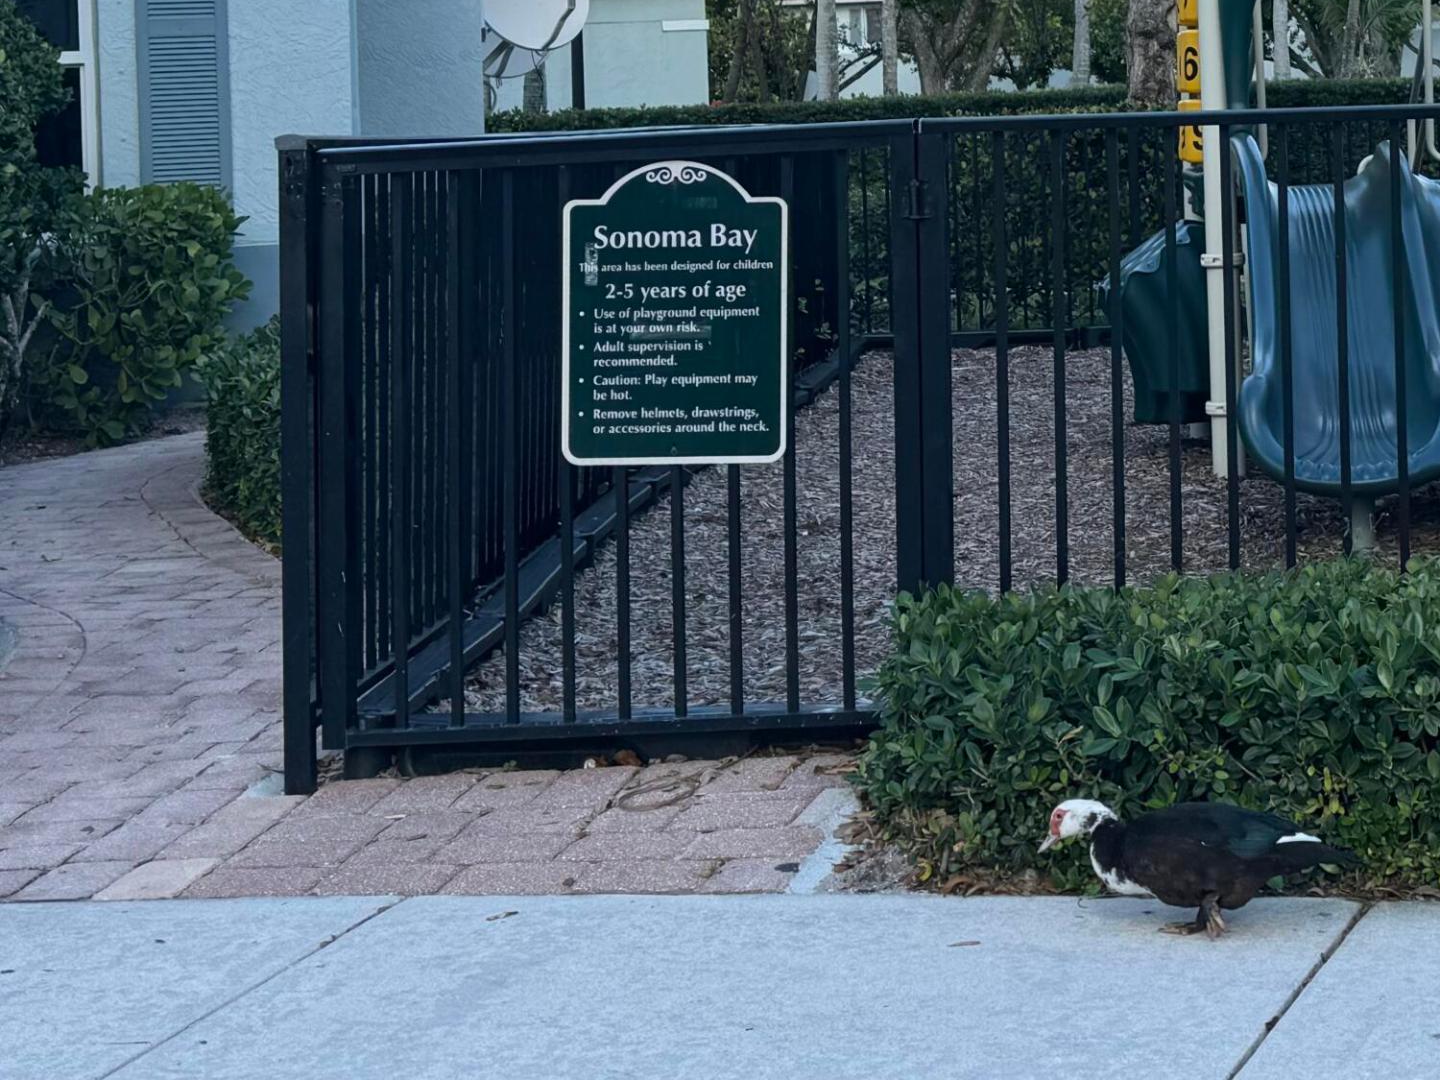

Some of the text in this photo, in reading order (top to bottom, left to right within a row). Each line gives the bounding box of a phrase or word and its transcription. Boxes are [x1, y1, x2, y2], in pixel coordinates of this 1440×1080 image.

[1184, 46, 1199, 81] 6
[594, 223, 757, 254] Sonoma Bay
[579, 260, 773, 272] This area has been designed for children
[605, 280, 746, 303] 2-5 years of age
[594, 307, 759, 321] Use of playground equipment
[594, 322, 700, 335] is at your own risk.
[593, 341, 703, 354] Adult supervision is
[593, 355, 678, 367] recommended.
[593, 374, 758, 387] Caution: Play equipment may
[593, 389, 632, 400] be hot.
[593, 407, 759, 420] Remove helmets, drawstrings,
[593, 421, 769, 433] or accessories around the neck.
